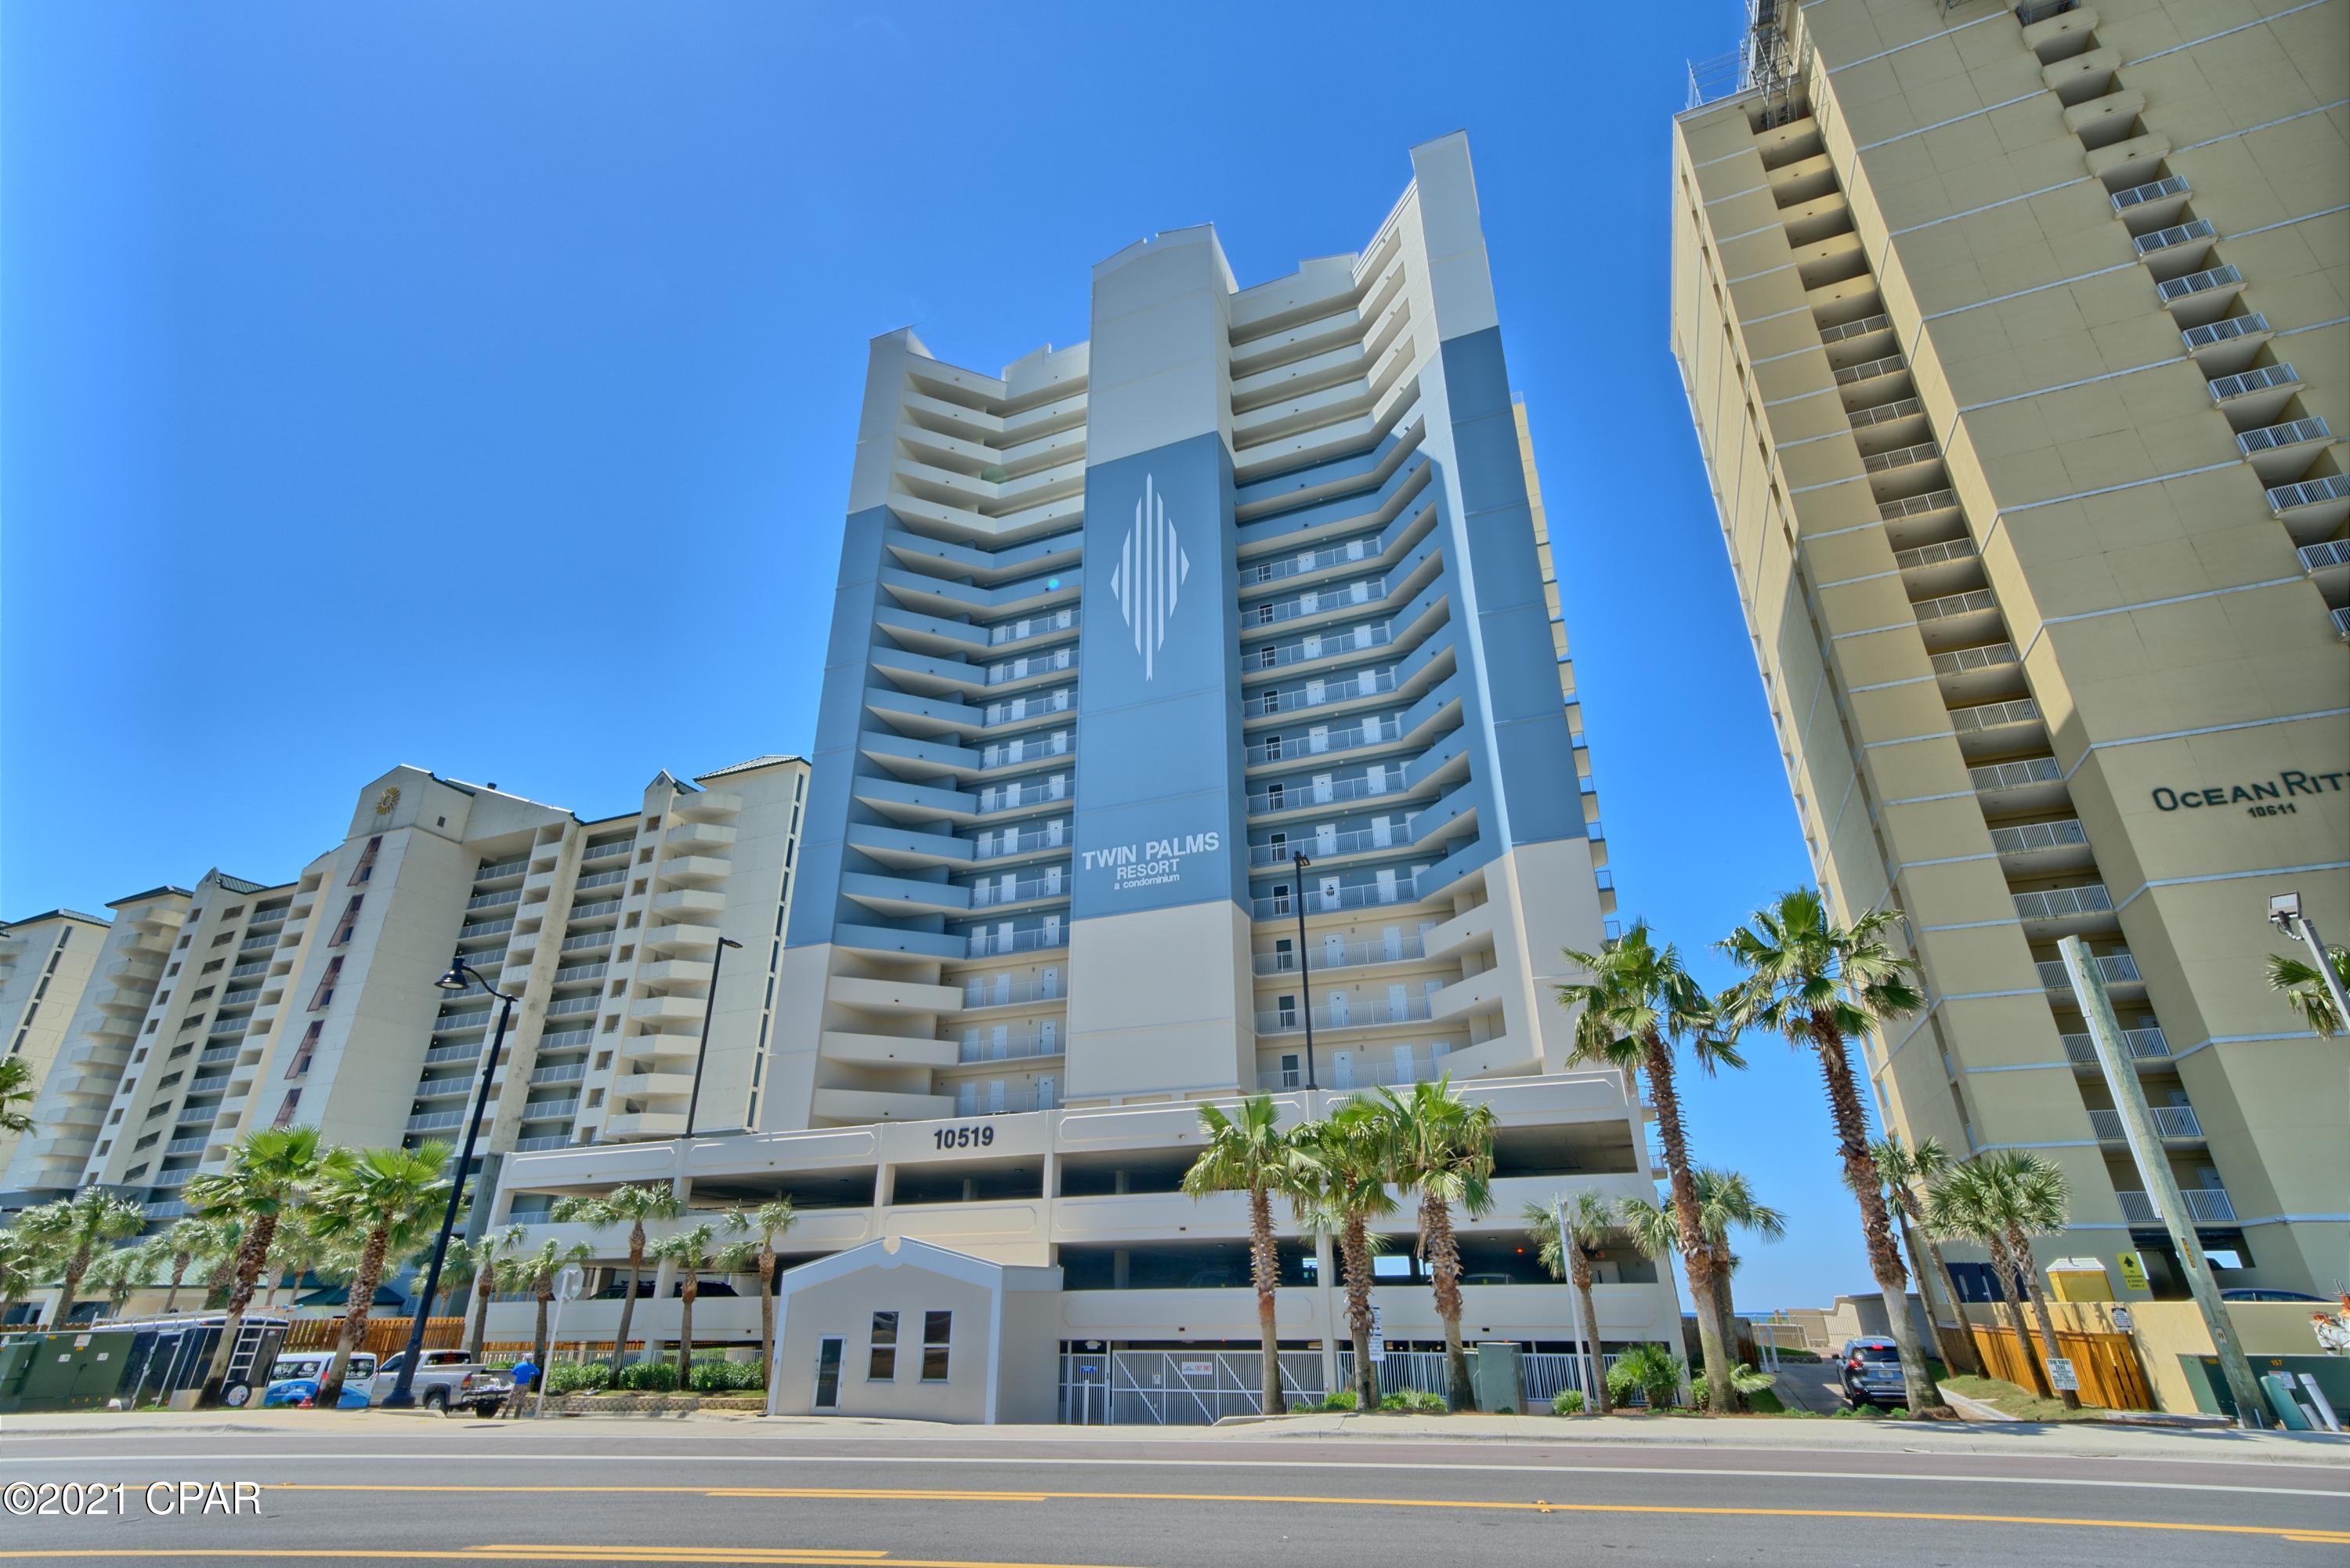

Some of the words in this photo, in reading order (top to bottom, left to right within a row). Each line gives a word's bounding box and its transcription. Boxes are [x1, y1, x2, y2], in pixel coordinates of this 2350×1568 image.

[2152, 782, 2280, 811] OCEAN
[2280, 771, 2350, 797] RIT
[2247, 802, 2297, 818] 10611
[1082, 844, 1137, 870] TWIN
[1145, 832, 1220, 860] PALMS
[1116, 858, 1180, 880] RESORT
[1123, 873, 1180, 889] condominium
[934, 1126, 994, 1150] 10519
